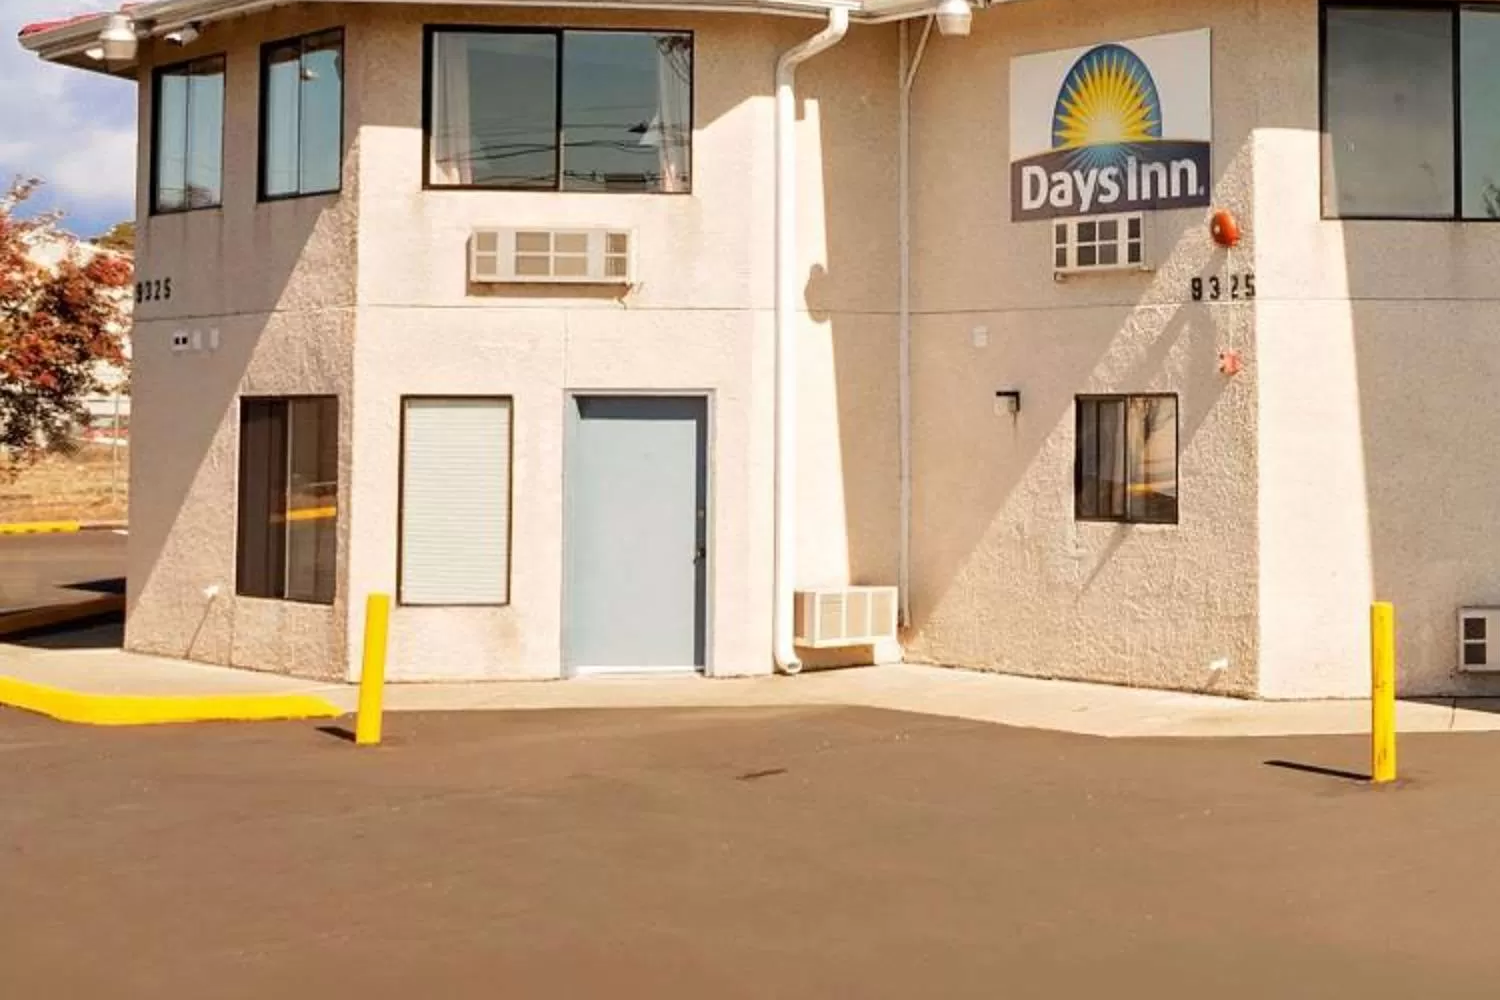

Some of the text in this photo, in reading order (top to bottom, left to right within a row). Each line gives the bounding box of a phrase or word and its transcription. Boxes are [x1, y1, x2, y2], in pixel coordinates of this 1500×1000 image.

[1021, 156, 1198, 213] Days Inn
[136, 277, 171, 304] 9325
[1191, 273, 1256, 301] 9325
